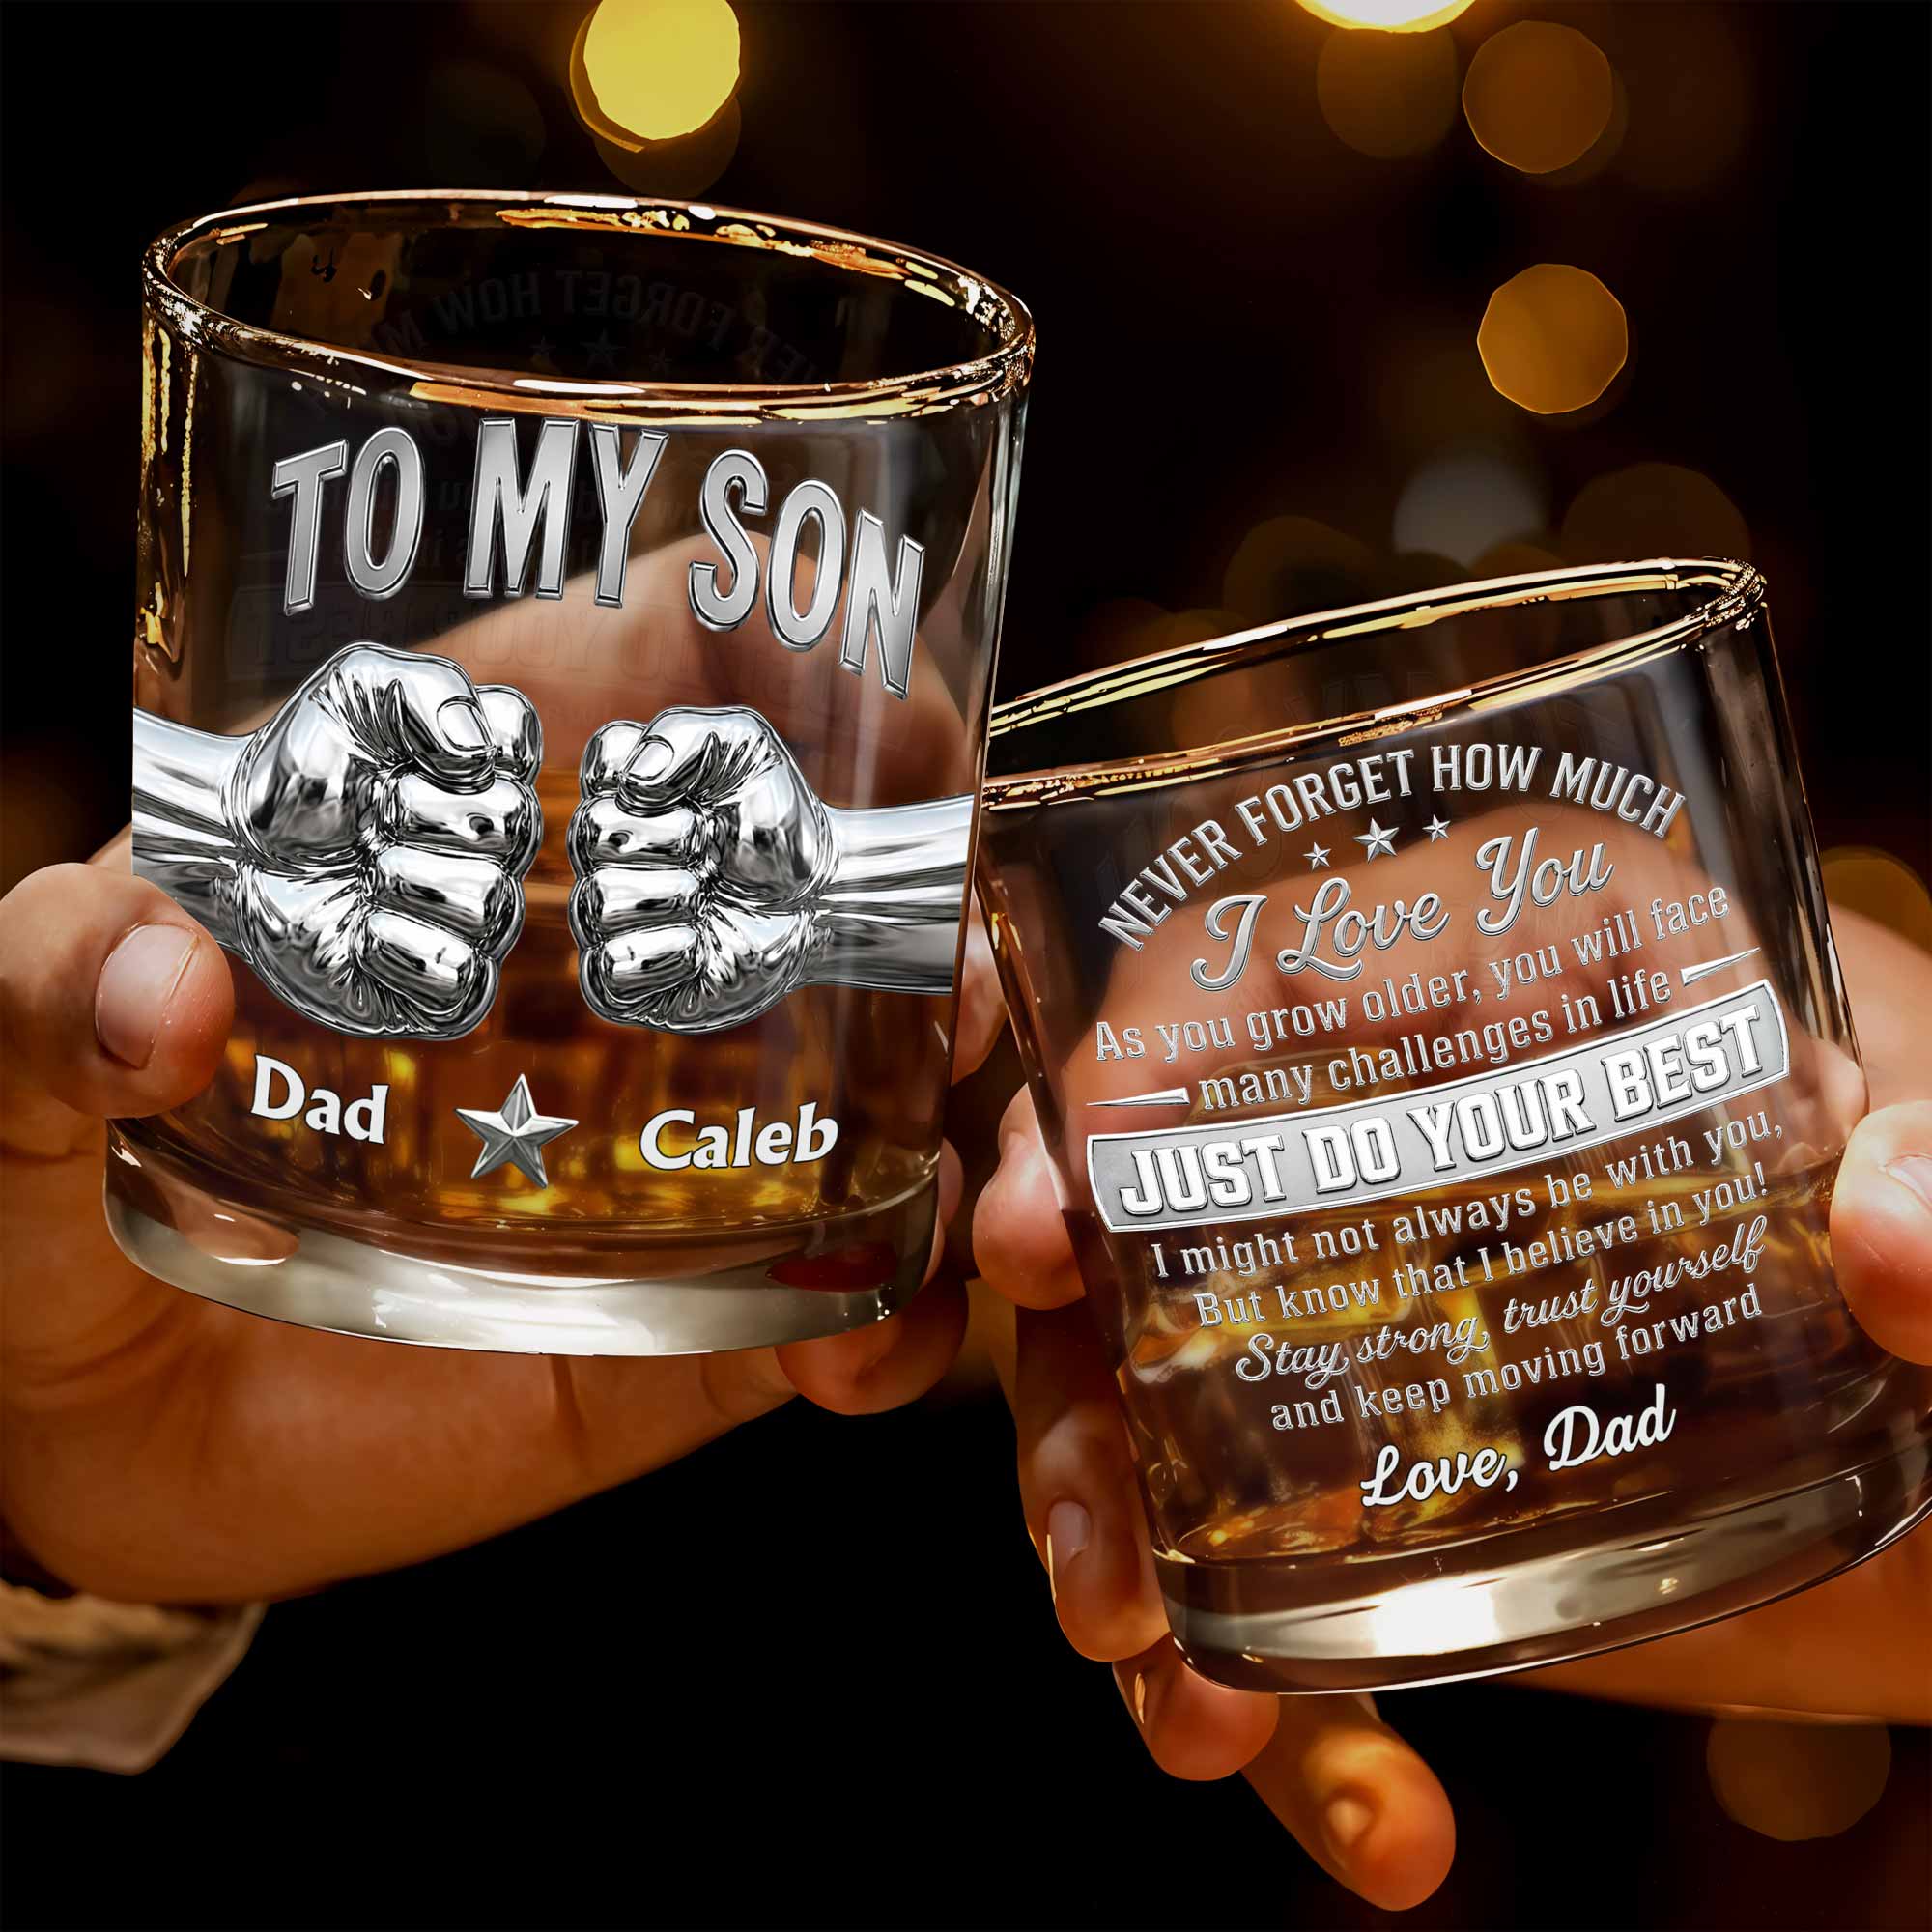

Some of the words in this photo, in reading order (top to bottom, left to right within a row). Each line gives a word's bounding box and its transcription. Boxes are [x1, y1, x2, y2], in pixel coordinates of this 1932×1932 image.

[272, 427, 426, 616] TO
[463, 418, 670, 609] MY
[688, 448, 926, 700] SON
[1097, 819, 1243, 952] NEVER
[1234, 749, 1413, 848] FORGET
[1430, 743, 1543, 793] HOW
[1550, 751, 1687, 839] MUCH
[1190, 895, 1267, 991] I
[1276, 877, 1450, 982] Love
[1475, 827, 1614, 937] You
[1096, 1020, 1145, 1063] As
[1156, 1015, 1235, 1064] you
[1246, 999, 1347, 1052] grow
[1363, 972, 1482, 1022] older,
[1491, 946, 1563, 999] you
[1573, 913, 1643, 964] will
[1650, 886, 1730, 937] face
[1200, 1064, 1312, 1111] many
[1329, 1012, 1553, 1091] challenges
[1562, 987, 1605, 1034] in
[1613, 970, 1673, 1020] life
[250, 1053, 389, 1145] Dad
[638, 1100, 840, 1172] Caleb
[1120, 1135, 1286, 1216] JUST
[1301, 1117, 1402, 1194] DO
[1407, 1067, 1597, 1172] YOUR
[1600, 1005, 1767, 1121] BEST
[1151, 1243, 1170, 1278] I
[1179, 1229, 1298, 1275] might
[1312, 1218, 1379, 1259] not
[1395, 1184, 1537, 1244] always
[1544, 1166, 1593, 1208] be
[1605, 1136, 1693, 1188] with
[1704, 1110, 1784, 1168] you,
[1193, 1290, 1264, 1328] But
[1279, 1278, 1380, 1319] know
[1392, 1263, 1467, 1300] that
[1475, 1248, 1494, 1284] I
[1505, 1216, 1639, 1274] believe
[1646, 1201, 1685, 1232] in
[1696, 1161, 1769, 1220] you!
[1236, 1333, 1351, 1392] Stay
[1356, 1311, 1492, 1368] strong,
[1503, 1277, 1599, 1334] trust
[1600, 1214, 1768, 1325] yourself
[1270, 1393, 1345, 1431] and
[1356, 1378, 1451, 1425] keep
[1465, 1335, 1603, 1401] moving
[1615, 1282, 1762, 1359] forward
[1359, 1444, 1520, 1508] Love,
[1543, 1382, 1677, 1472] Dad
